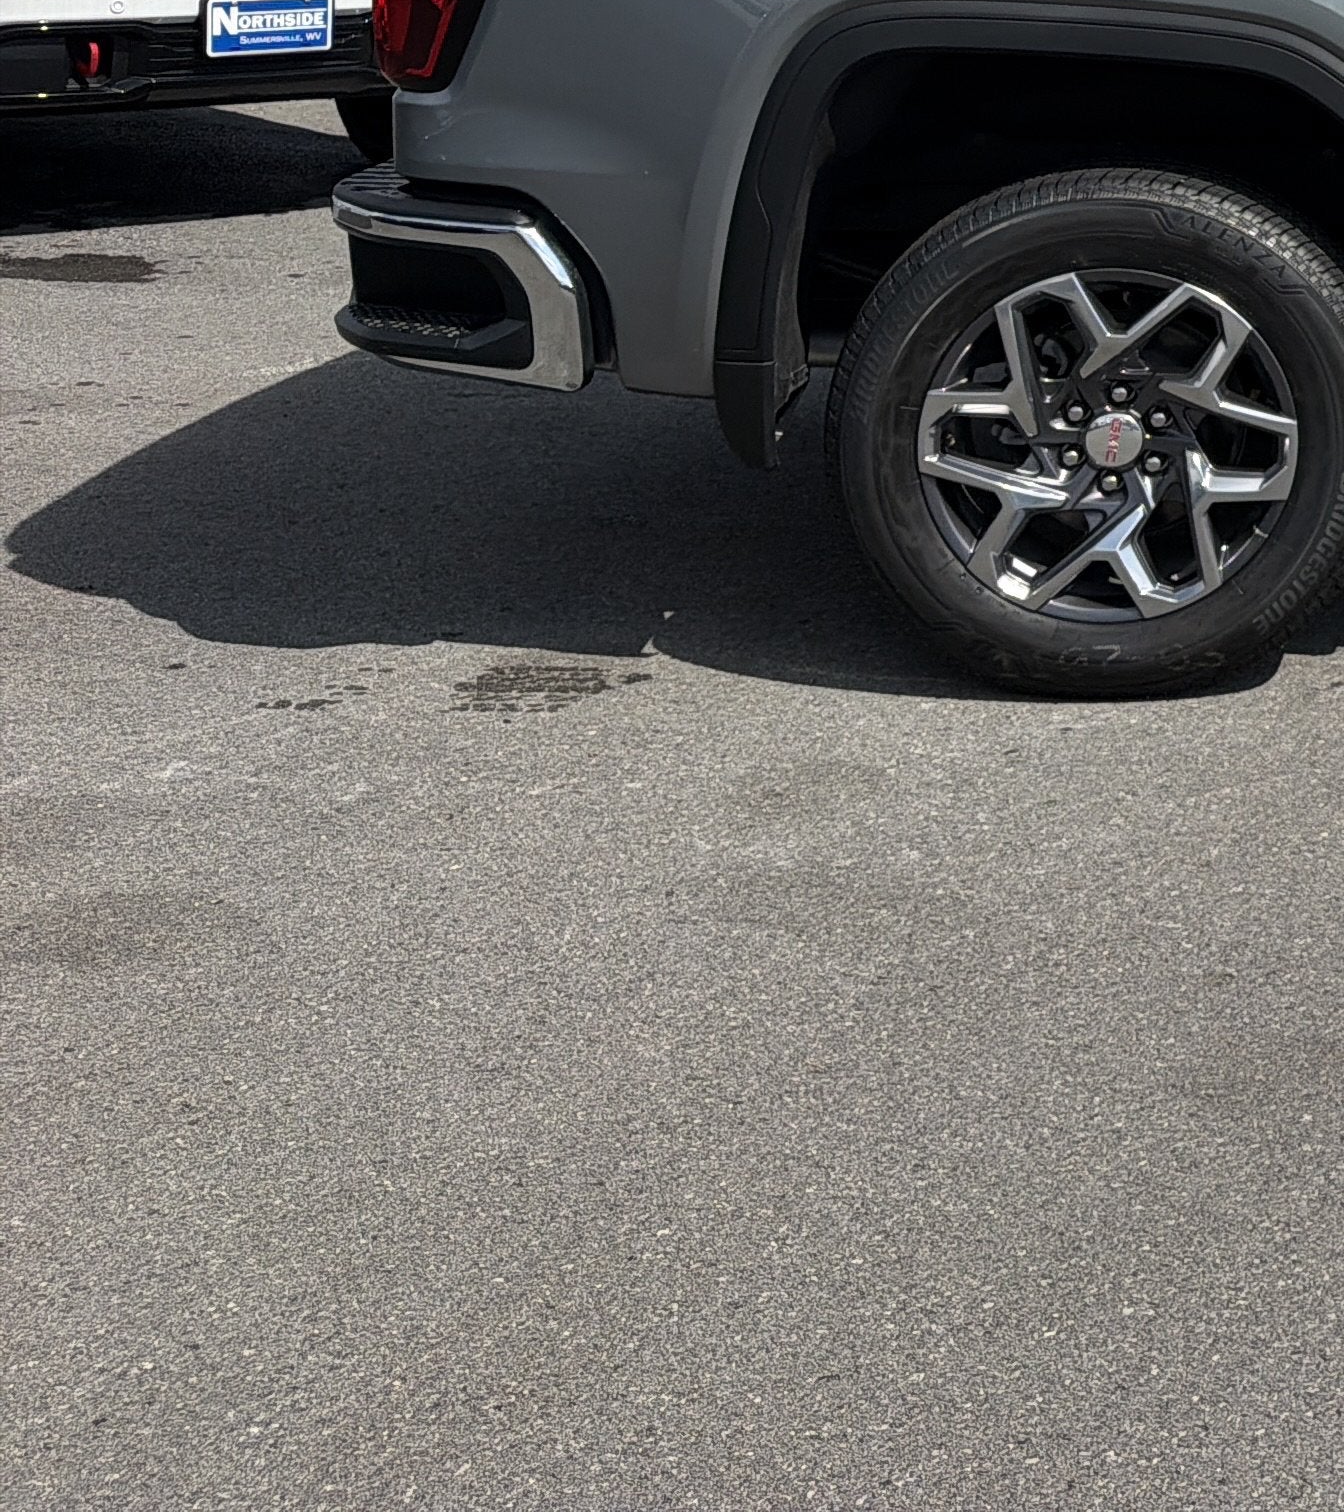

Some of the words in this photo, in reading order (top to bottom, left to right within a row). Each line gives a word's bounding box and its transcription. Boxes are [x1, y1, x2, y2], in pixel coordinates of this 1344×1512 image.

[213, 6, 325, 36] NORTHSIDE
[305, 32, 322, 41] WV
[1104, 417, 1123, 463] GMC
